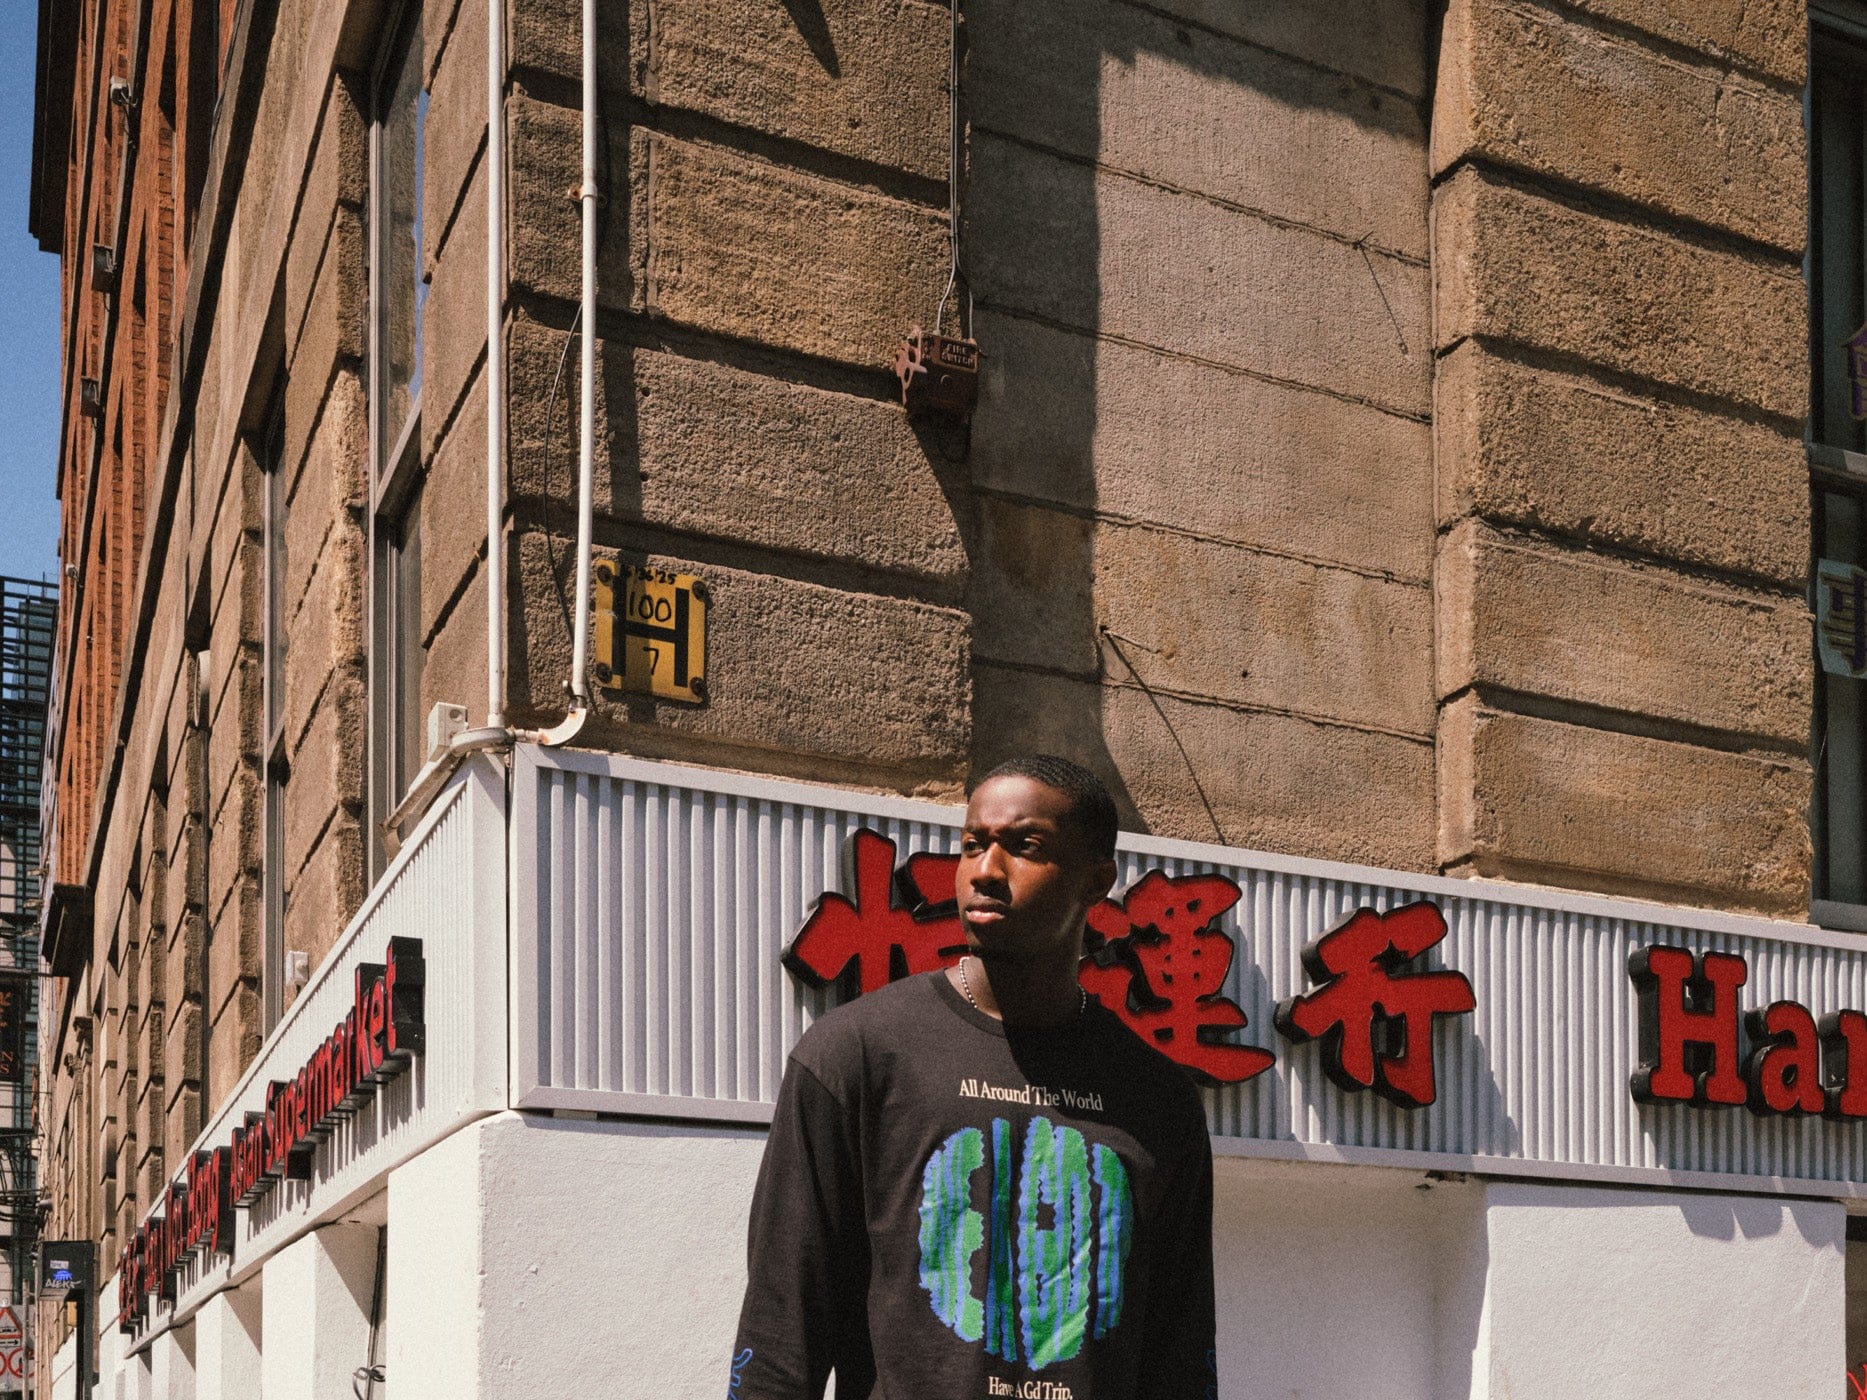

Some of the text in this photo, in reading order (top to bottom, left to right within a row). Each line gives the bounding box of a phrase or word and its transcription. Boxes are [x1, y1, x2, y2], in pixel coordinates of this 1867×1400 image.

[629, 590, 672, 622] 100
[611, 573, 690, 688] H
[643, 646, 659, 676] 7
[265, 942, 398, 1181] Supermarket
[959, 1079, 1104, 1112] All Around The World
[988, 1376, 1014, 1397] Have
[1014, 1381, 1023, 1399] A
[1023, 1380, 1041, 1400] Gd
